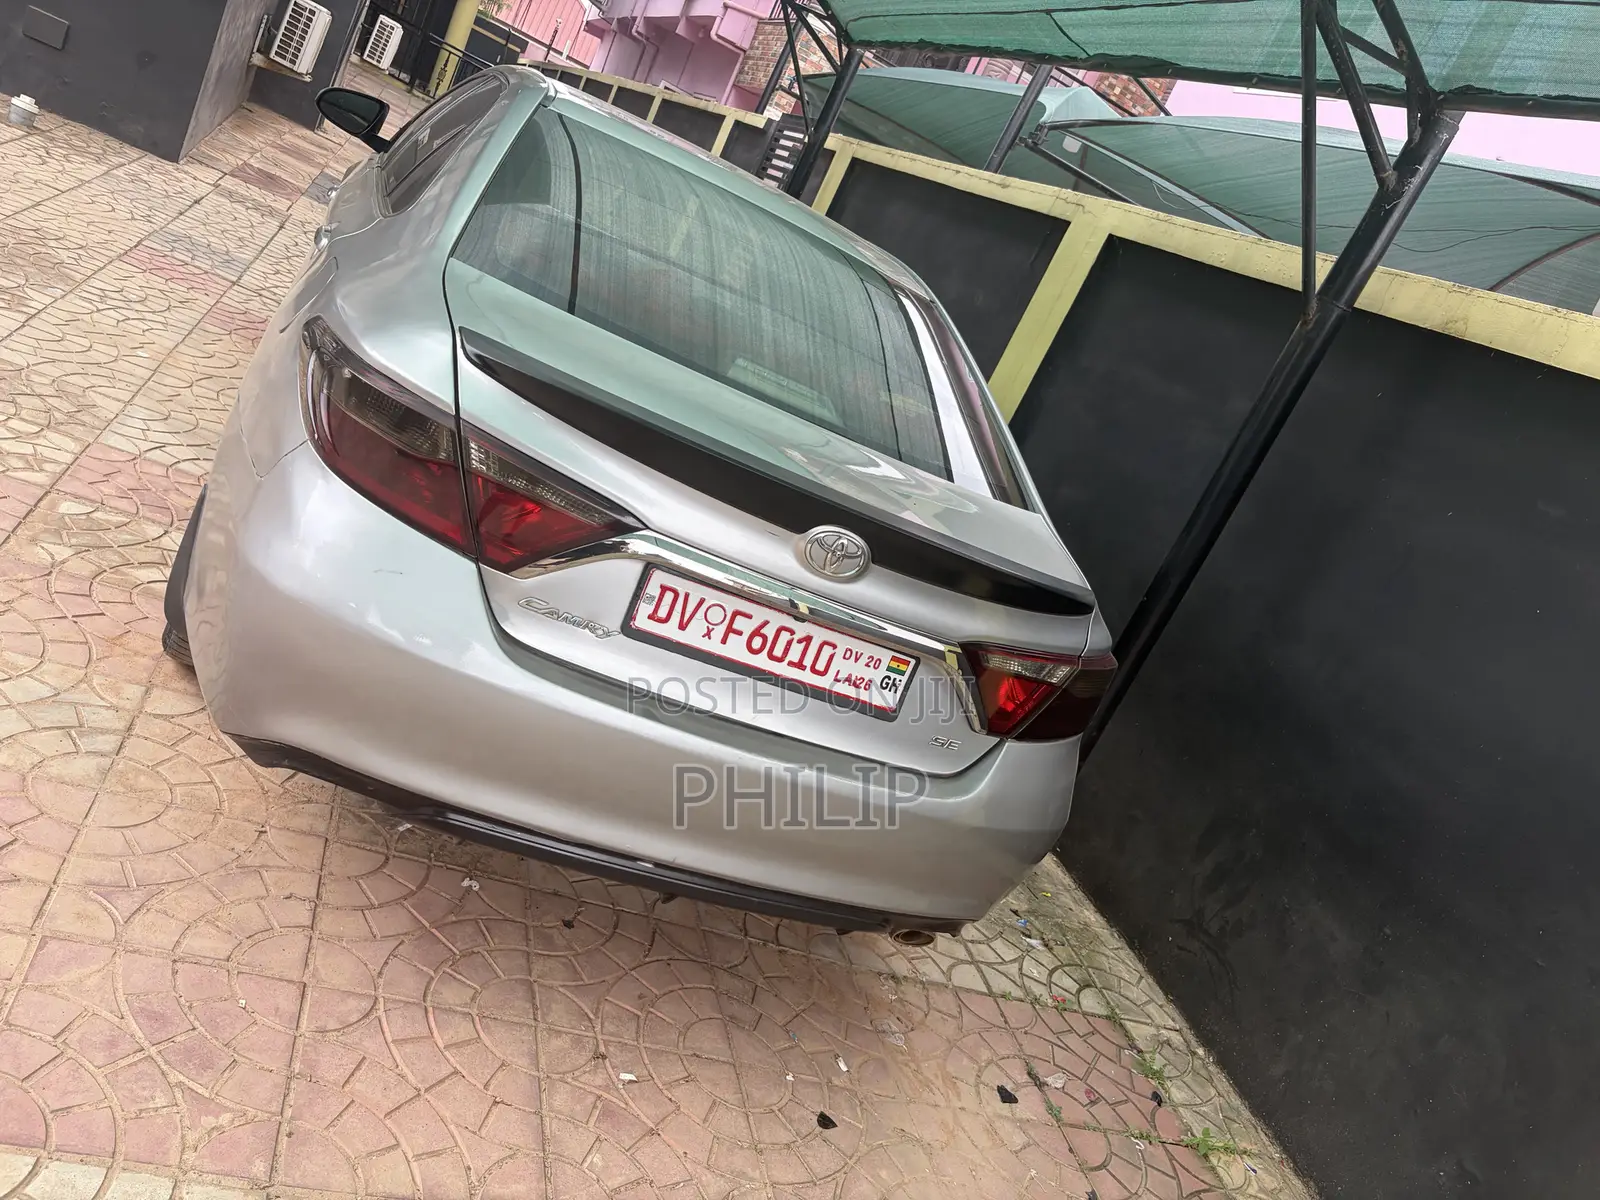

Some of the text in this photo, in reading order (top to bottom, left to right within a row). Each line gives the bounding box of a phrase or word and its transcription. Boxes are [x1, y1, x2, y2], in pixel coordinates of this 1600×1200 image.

[518, 597, 621, 639] CAMRY
[647, 584, 838, 677] DV F6010
[842, 647, 882, 670] DV 20
[880, 675, 902, 694] GH
[928, 735, 962, 750] SE
